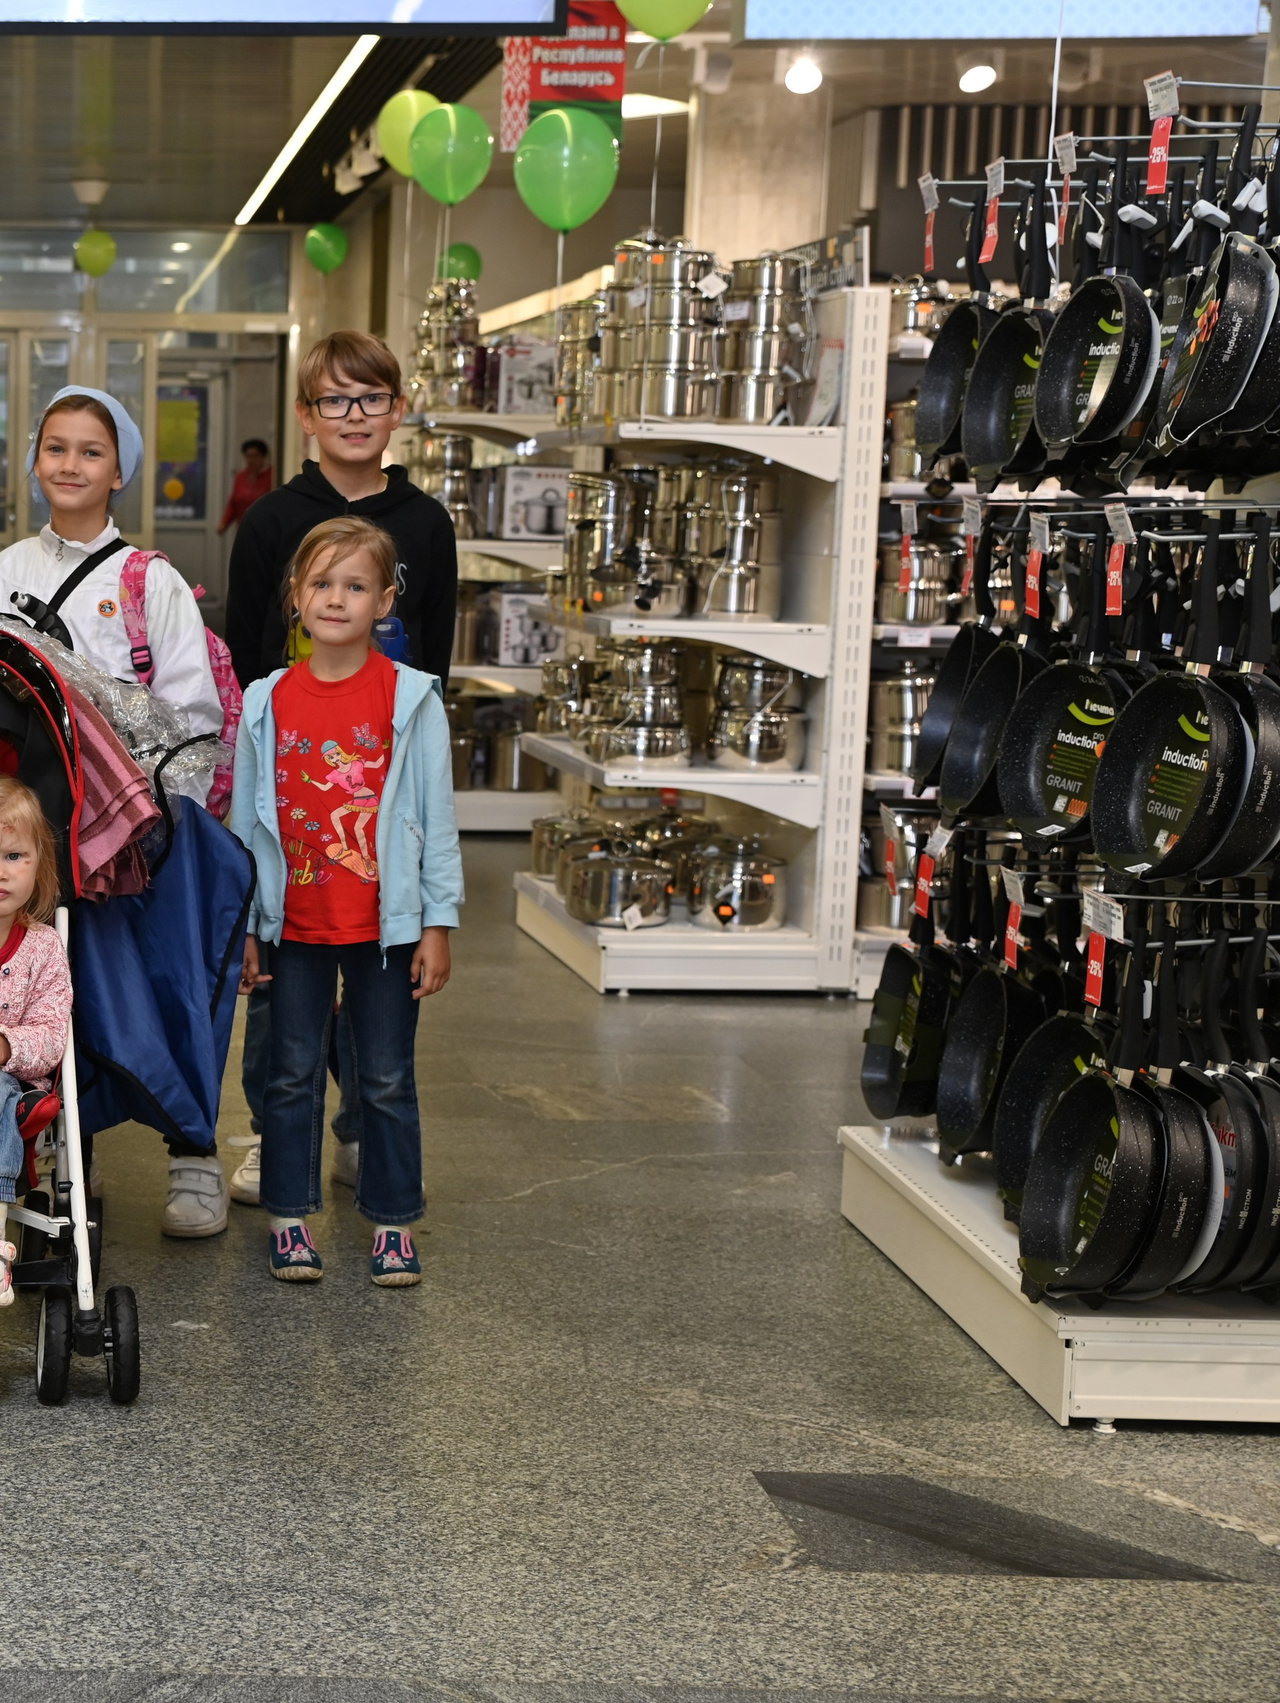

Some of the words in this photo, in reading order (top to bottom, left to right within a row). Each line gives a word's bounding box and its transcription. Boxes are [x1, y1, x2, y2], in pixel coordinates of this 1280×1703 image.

[540, 67, 616, 88] Беларусь
[1150, 146, 1167, 164] -25%
[1089, 342, 1121, 357] inductio
[1057, 729, 1098, 750] induction
[1092, 731, 1105, 743] pro
[1162, 746, 1206, 772] induction
[1046, 774, 1083, 794] GRANIT
[1146, 800, 1183, 822] GRANIT
[1087, 959, 1102, 978] -25%
[1094, 1153, 1113, 1180] GRA
